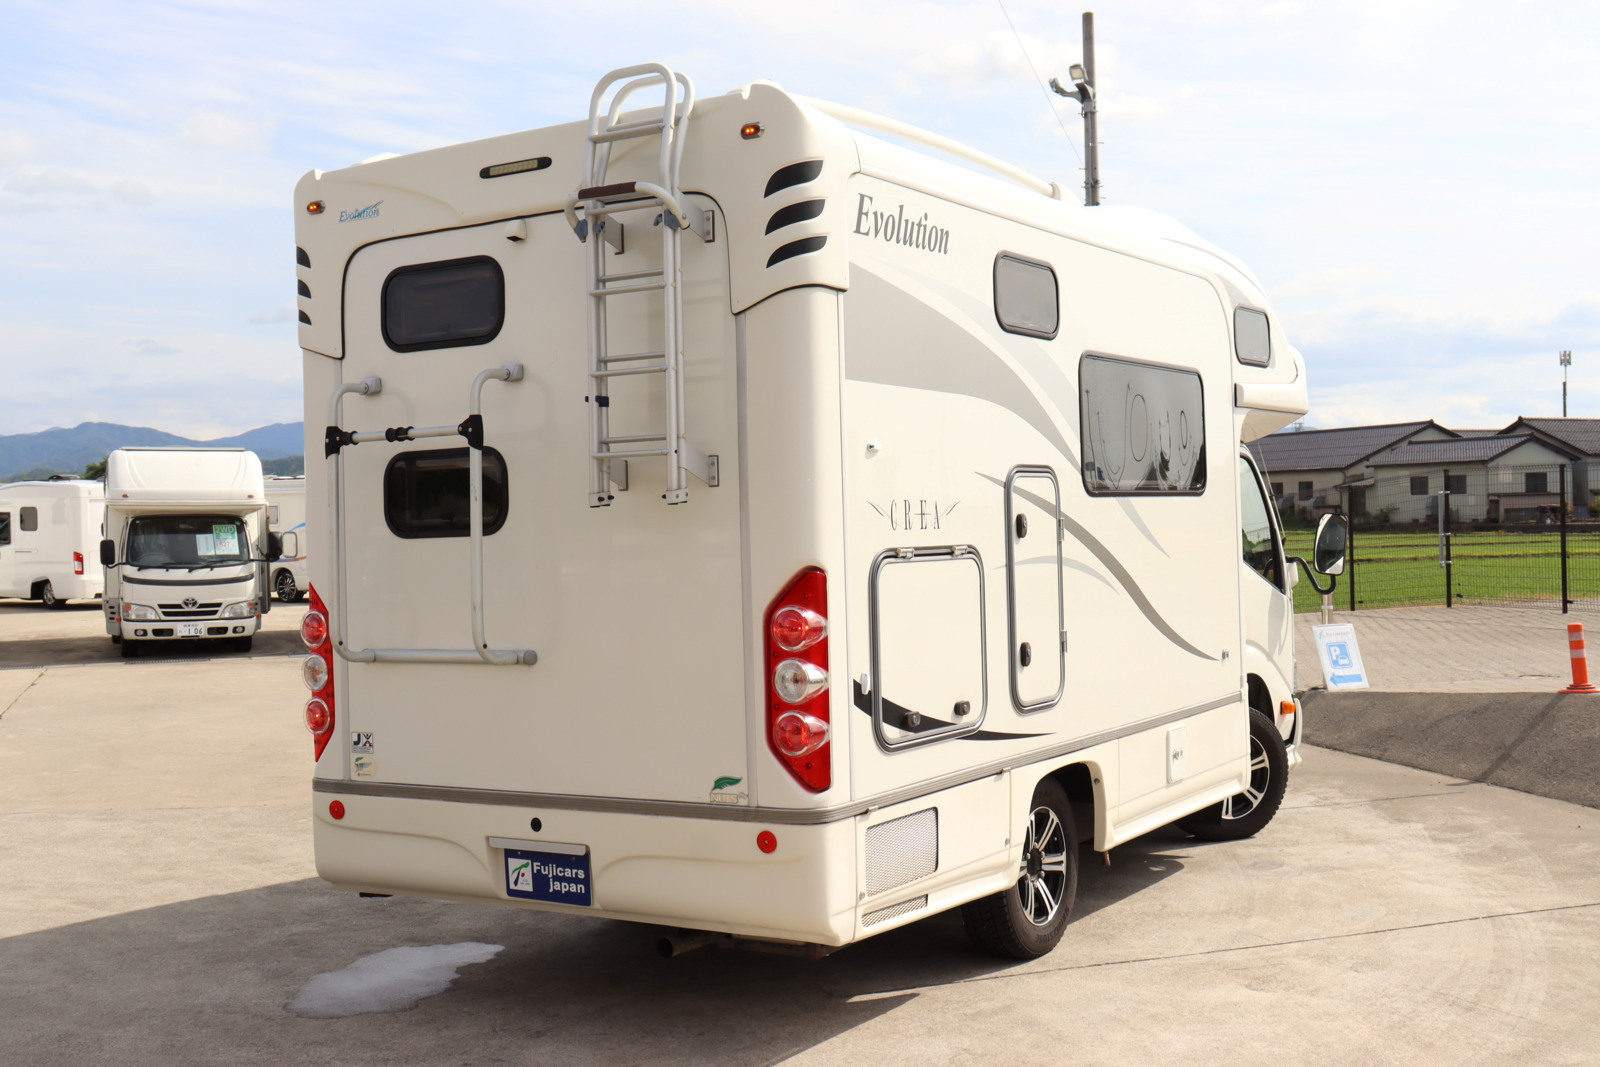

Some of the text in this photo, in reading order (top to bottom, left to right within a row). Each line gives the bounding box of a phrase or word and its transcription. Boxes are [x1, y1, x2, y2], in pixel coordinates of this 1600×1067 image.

[339, 208, 380, 222] Evolution
[853, 192, 950, 255] Evolution
[890, 499, 941, 531] CREA
[1329, 646, 1341, 661] P
[533, 861, 585, 879] Fujicars
[549, 878, 585, 894] japan
